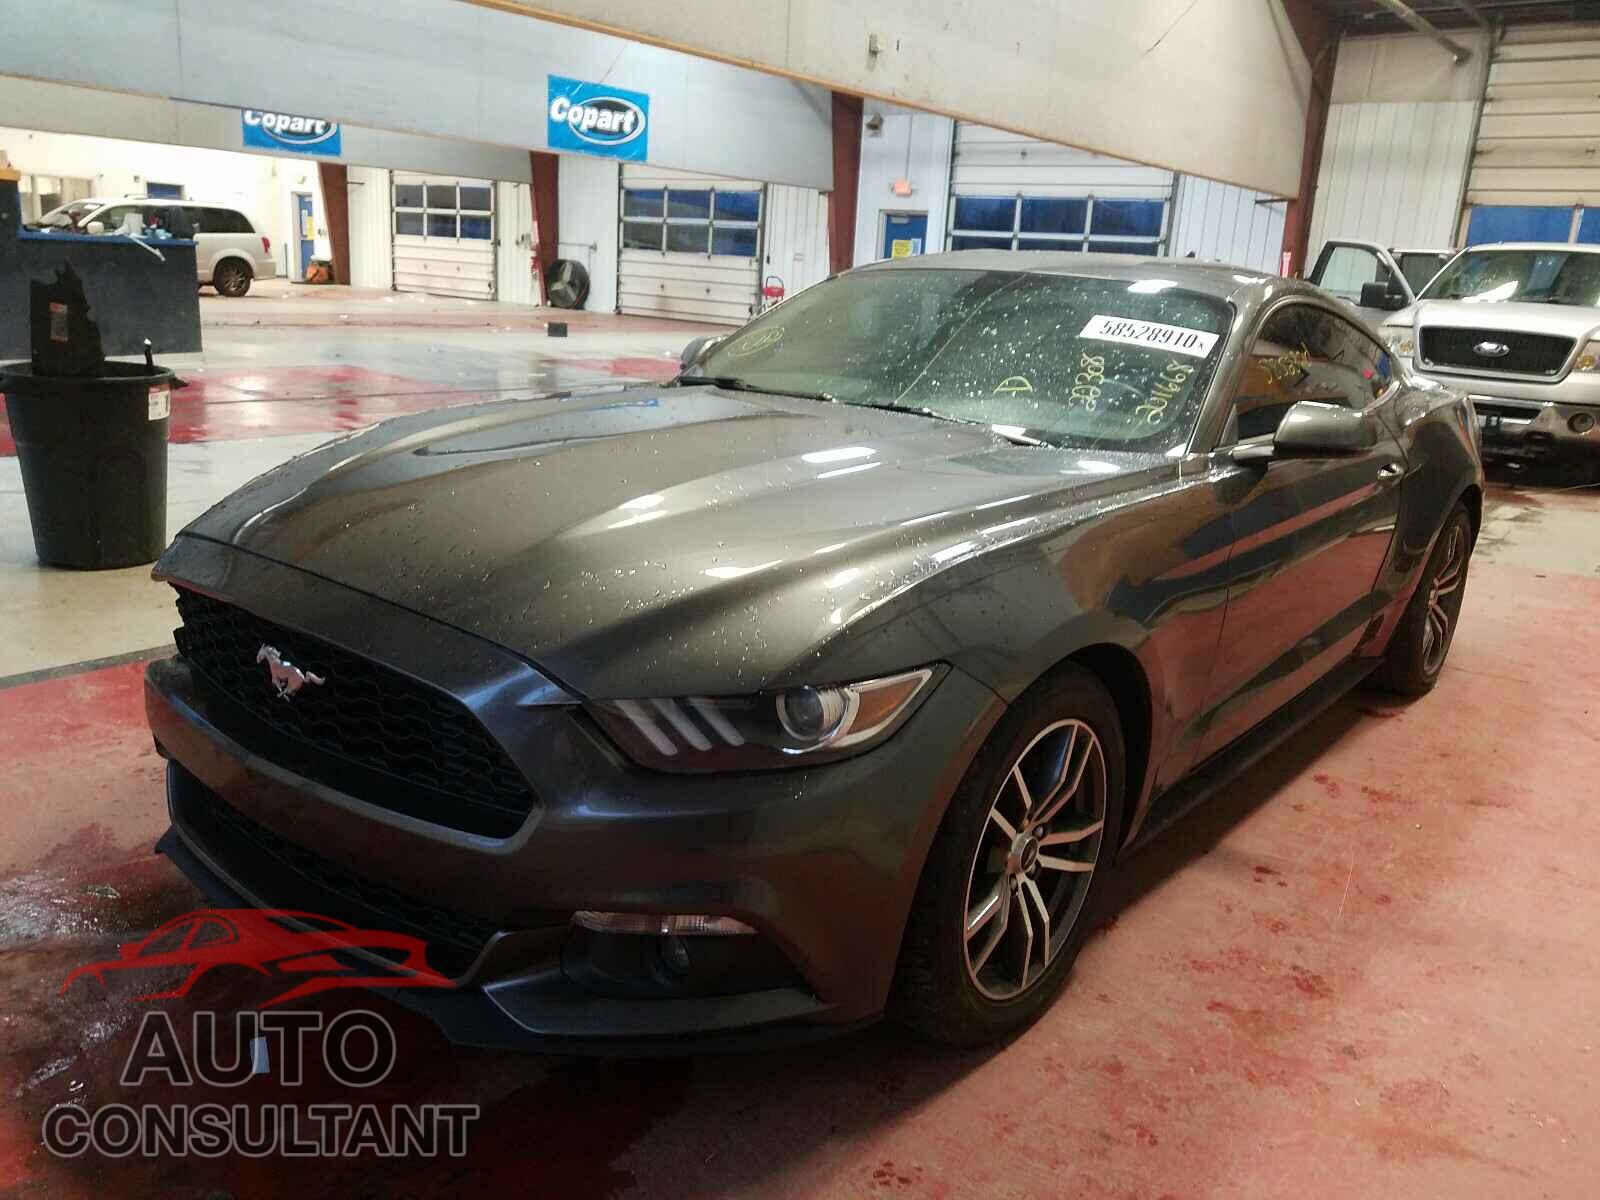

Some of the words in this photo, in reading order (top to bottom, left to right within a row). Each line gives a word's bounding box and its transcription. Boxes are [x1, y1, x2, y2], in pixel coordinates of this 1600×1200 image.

[244, 109, 326, 135] Copart
[550, 95, 635, 135] Copart
[1099, 320, 1199, 349] 58528910
